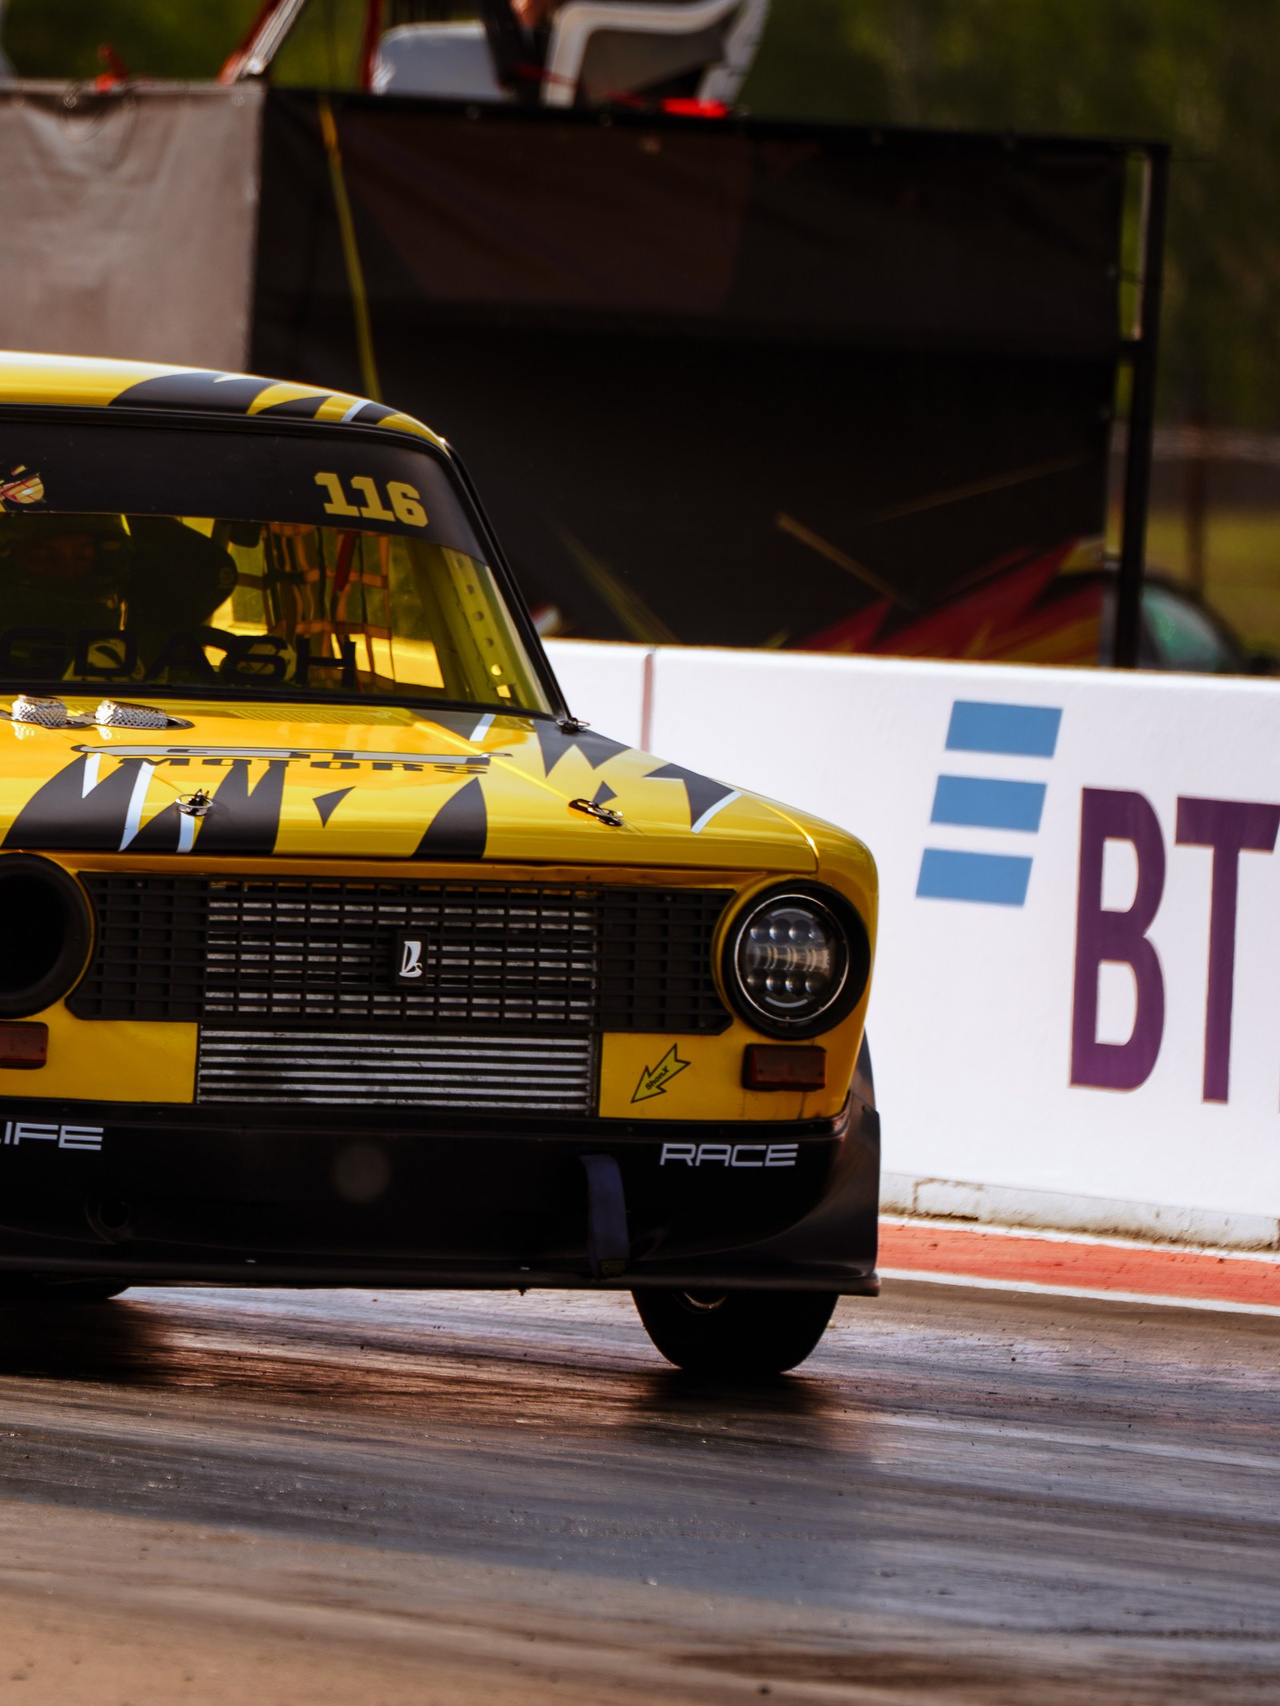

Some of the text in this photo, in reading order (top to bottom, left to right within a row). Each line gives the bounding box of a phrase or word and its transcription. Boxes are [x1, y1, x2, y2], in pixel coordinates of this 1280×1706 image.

[314, 472, 429, 527] 116
[118, 757, 489, 775] MOTORS
[1068, 786, 1280, 1113] ВТ
[659, 1143, 799, 1167] RACE
